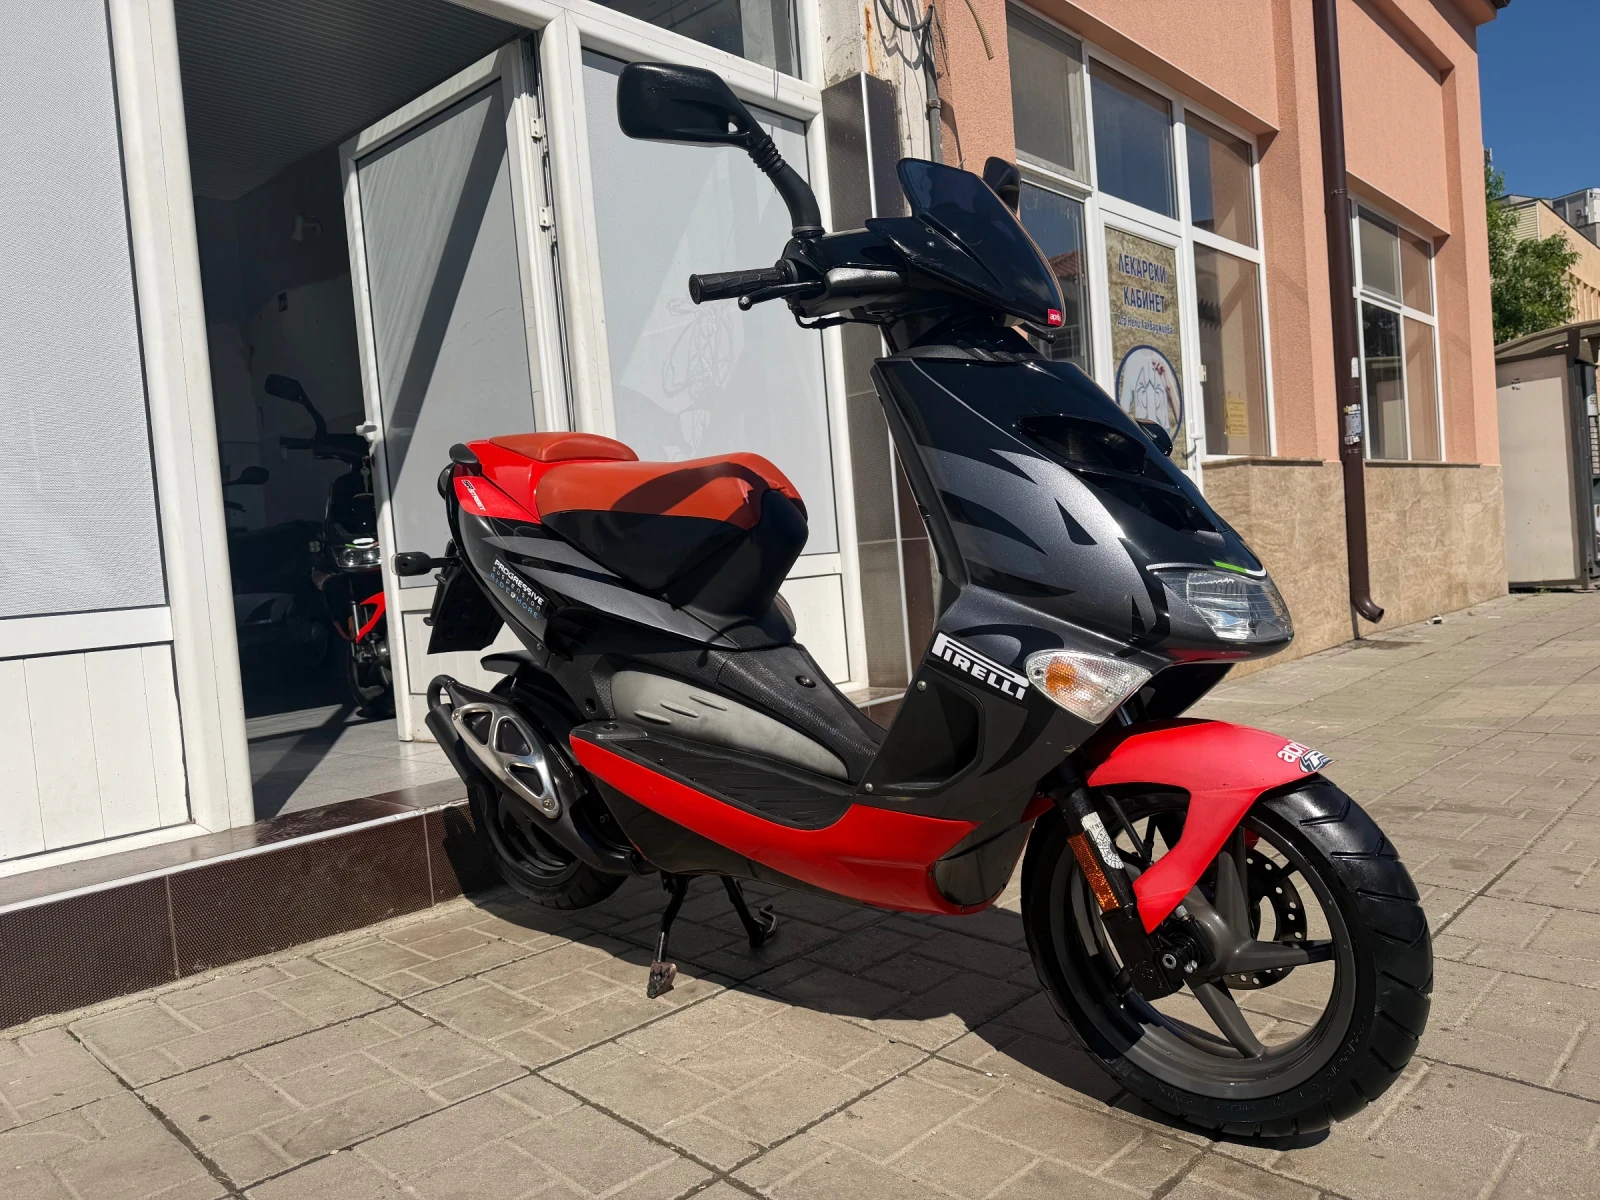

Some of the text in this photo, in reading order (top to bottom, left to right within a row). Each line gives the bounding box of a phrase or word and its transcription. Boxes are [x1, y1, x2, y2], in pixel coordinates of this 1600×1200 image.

[1118, 253, 1167, 284] ЛЕКАРСКИ
[1123, 286, 1165, 313] КАБИНЕТ
[494, 559, 544, 605] PROGRESSIVE
[515, 596, 539, 619] MORE
[931, 632, 1030, 700] PIRELLI
